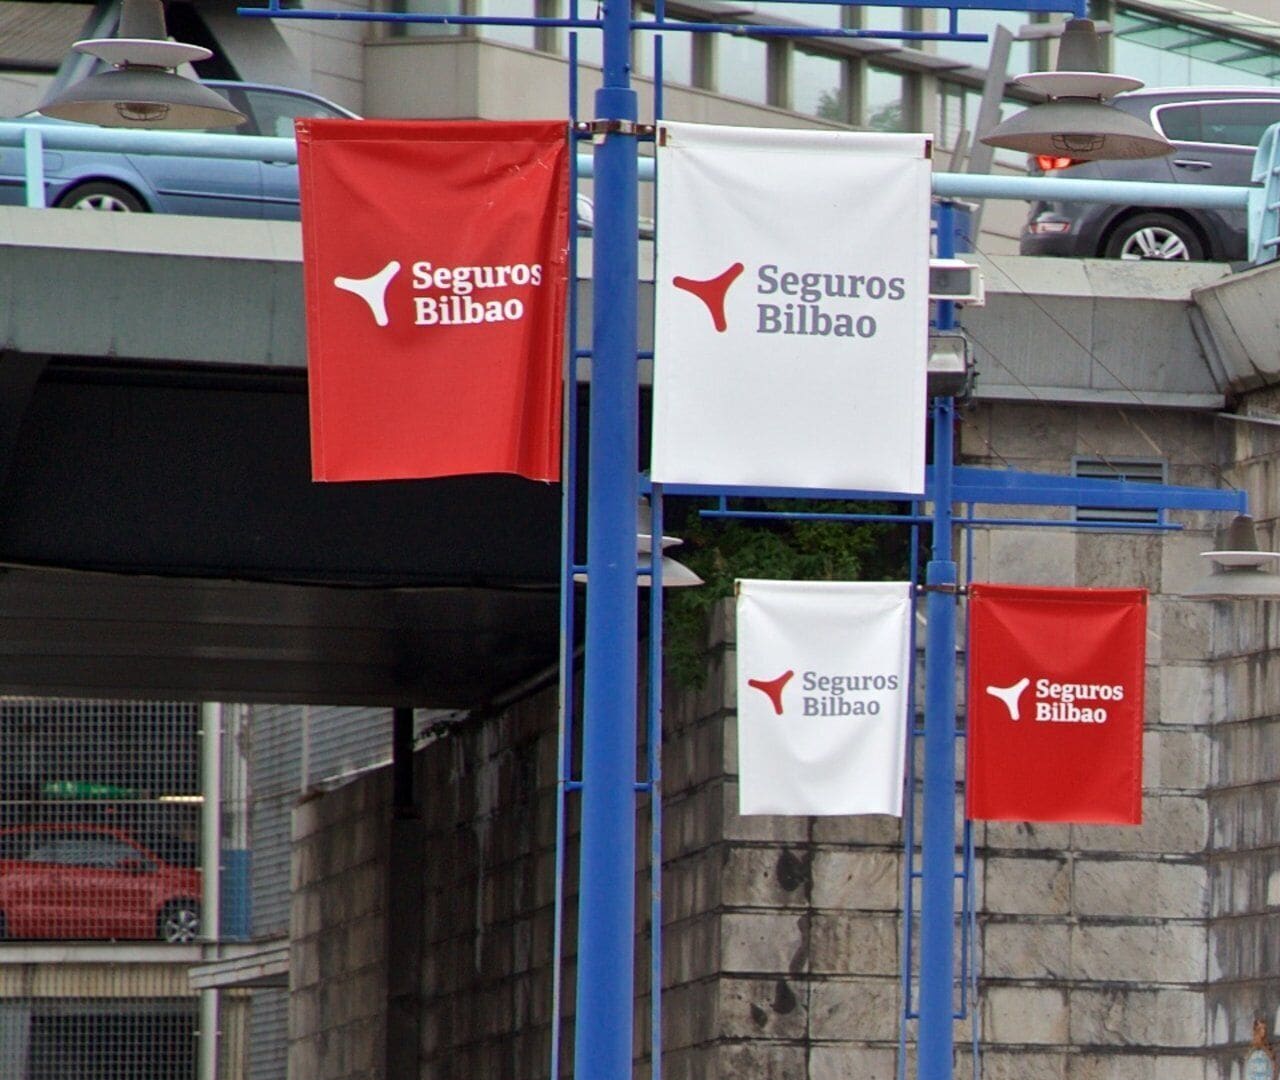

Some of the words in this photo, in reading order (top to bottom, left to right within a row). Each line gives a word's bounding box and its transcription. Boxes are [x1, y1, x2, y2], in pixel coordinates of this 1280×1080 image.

[411, 260, 542, 294] Seguros
[755, 262, 907, 303] Seguros
[413, 295, 524, 326] Bilbao
[756, 303, 878, 339] Bilbao
[801, 669, 899, 696] Seguros
[1035, 678, 1124, 703] Seguros
[802, 695, 881, 718] Bilbao
[1035, 701, 1107, 724] Bilbao
